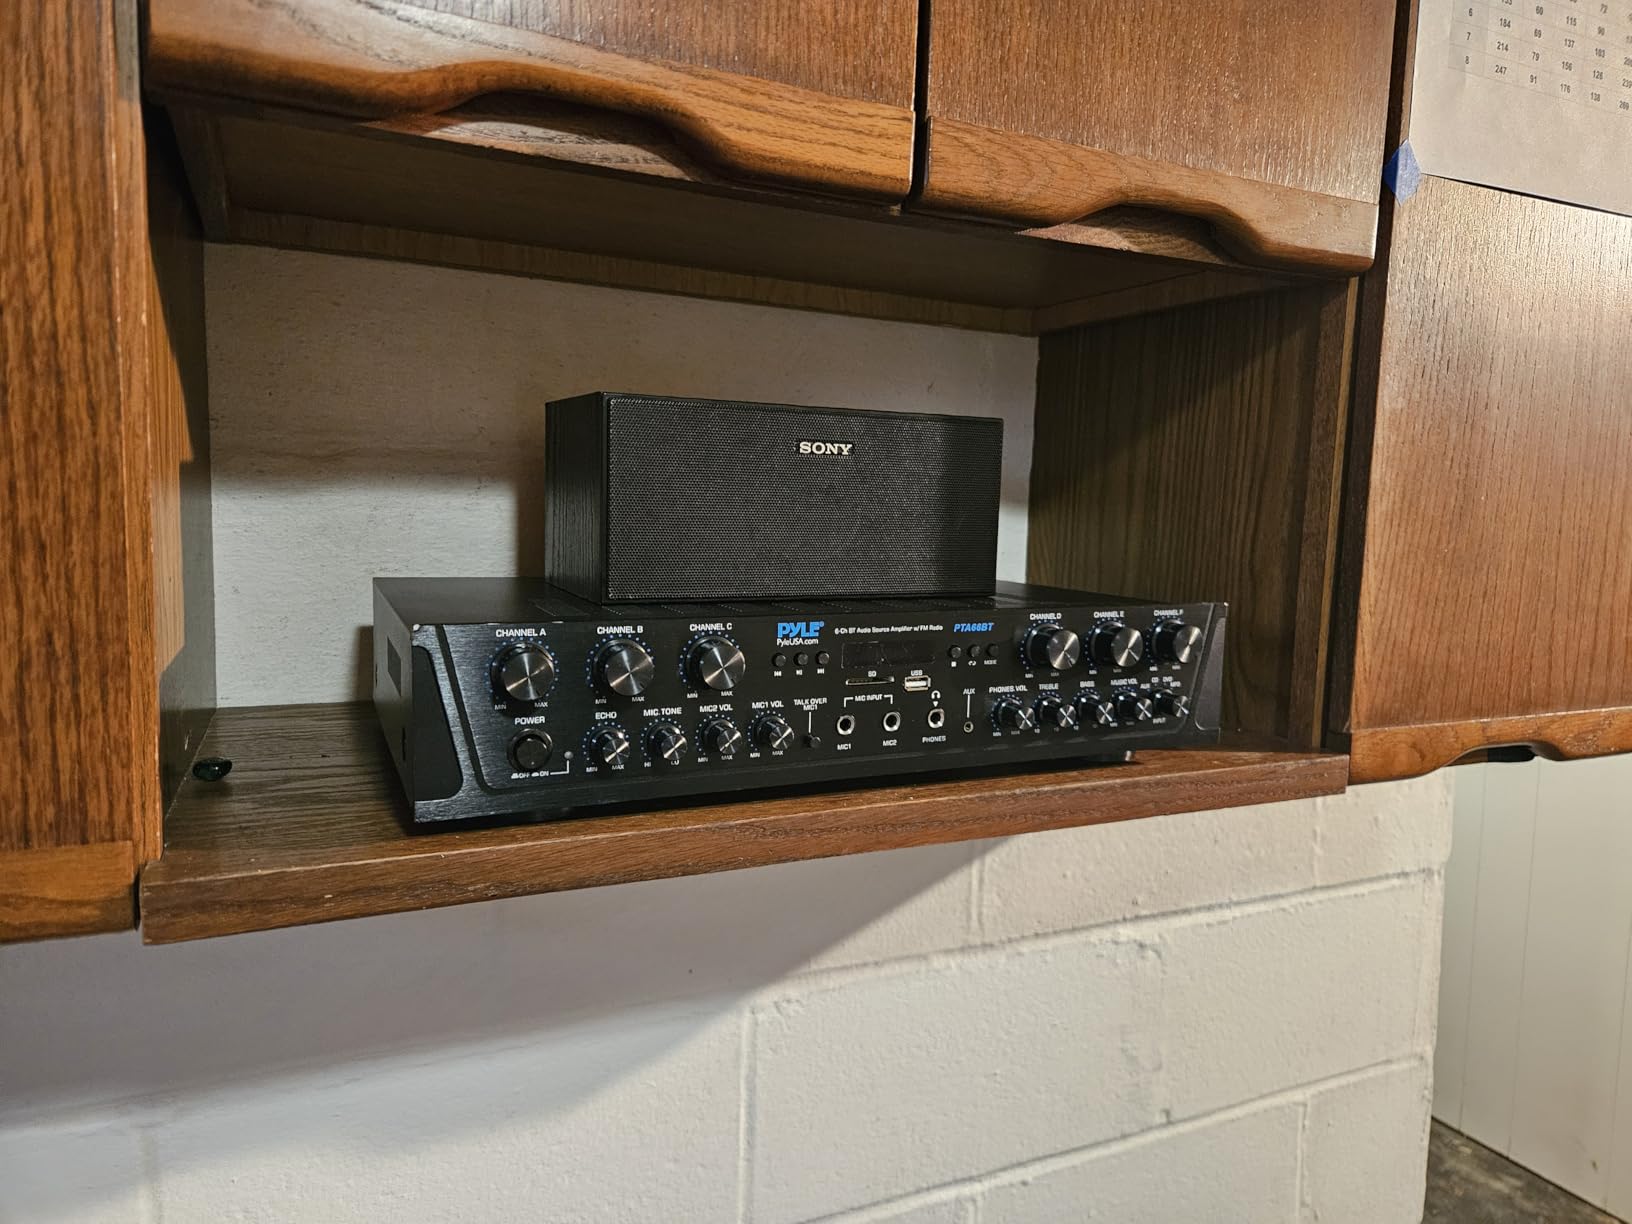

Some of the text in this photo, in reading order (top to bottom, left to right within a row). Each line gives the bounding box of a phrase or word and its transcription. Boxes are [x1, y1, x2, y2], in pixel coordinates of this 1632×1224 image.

[1468, 8, 1473, 17] 6
[1499, 17, 1511, 28] 184
[1564, 38, 1575, 49] 137
[1466, 31, 1471, 41] 7
[1496, 41, 1509, 52] 214
[1532, 51, 1540, 62] 79
[1464, 55, 1470, 65] 8
[1495, 64, 1507, 75] 247
[1529, 74, 1538, 84] 91
[799, 441, 853, 455] SONY
[596, 625, 644, 635] CHANNEL B
[689, 622, 733, 632] CHANNEL C
[495, 628, 547, 637] CHANNEL A
[770, 700, 785, 708] VOL
[793, 697, 828, 706] TALK OVER
[661, 706, 683, 715] TONE
[699, 704, 734, 713] MIC2 VOL
[595, 711, 617, 720] ECHO
[514, 716, 546, 725] POWER
